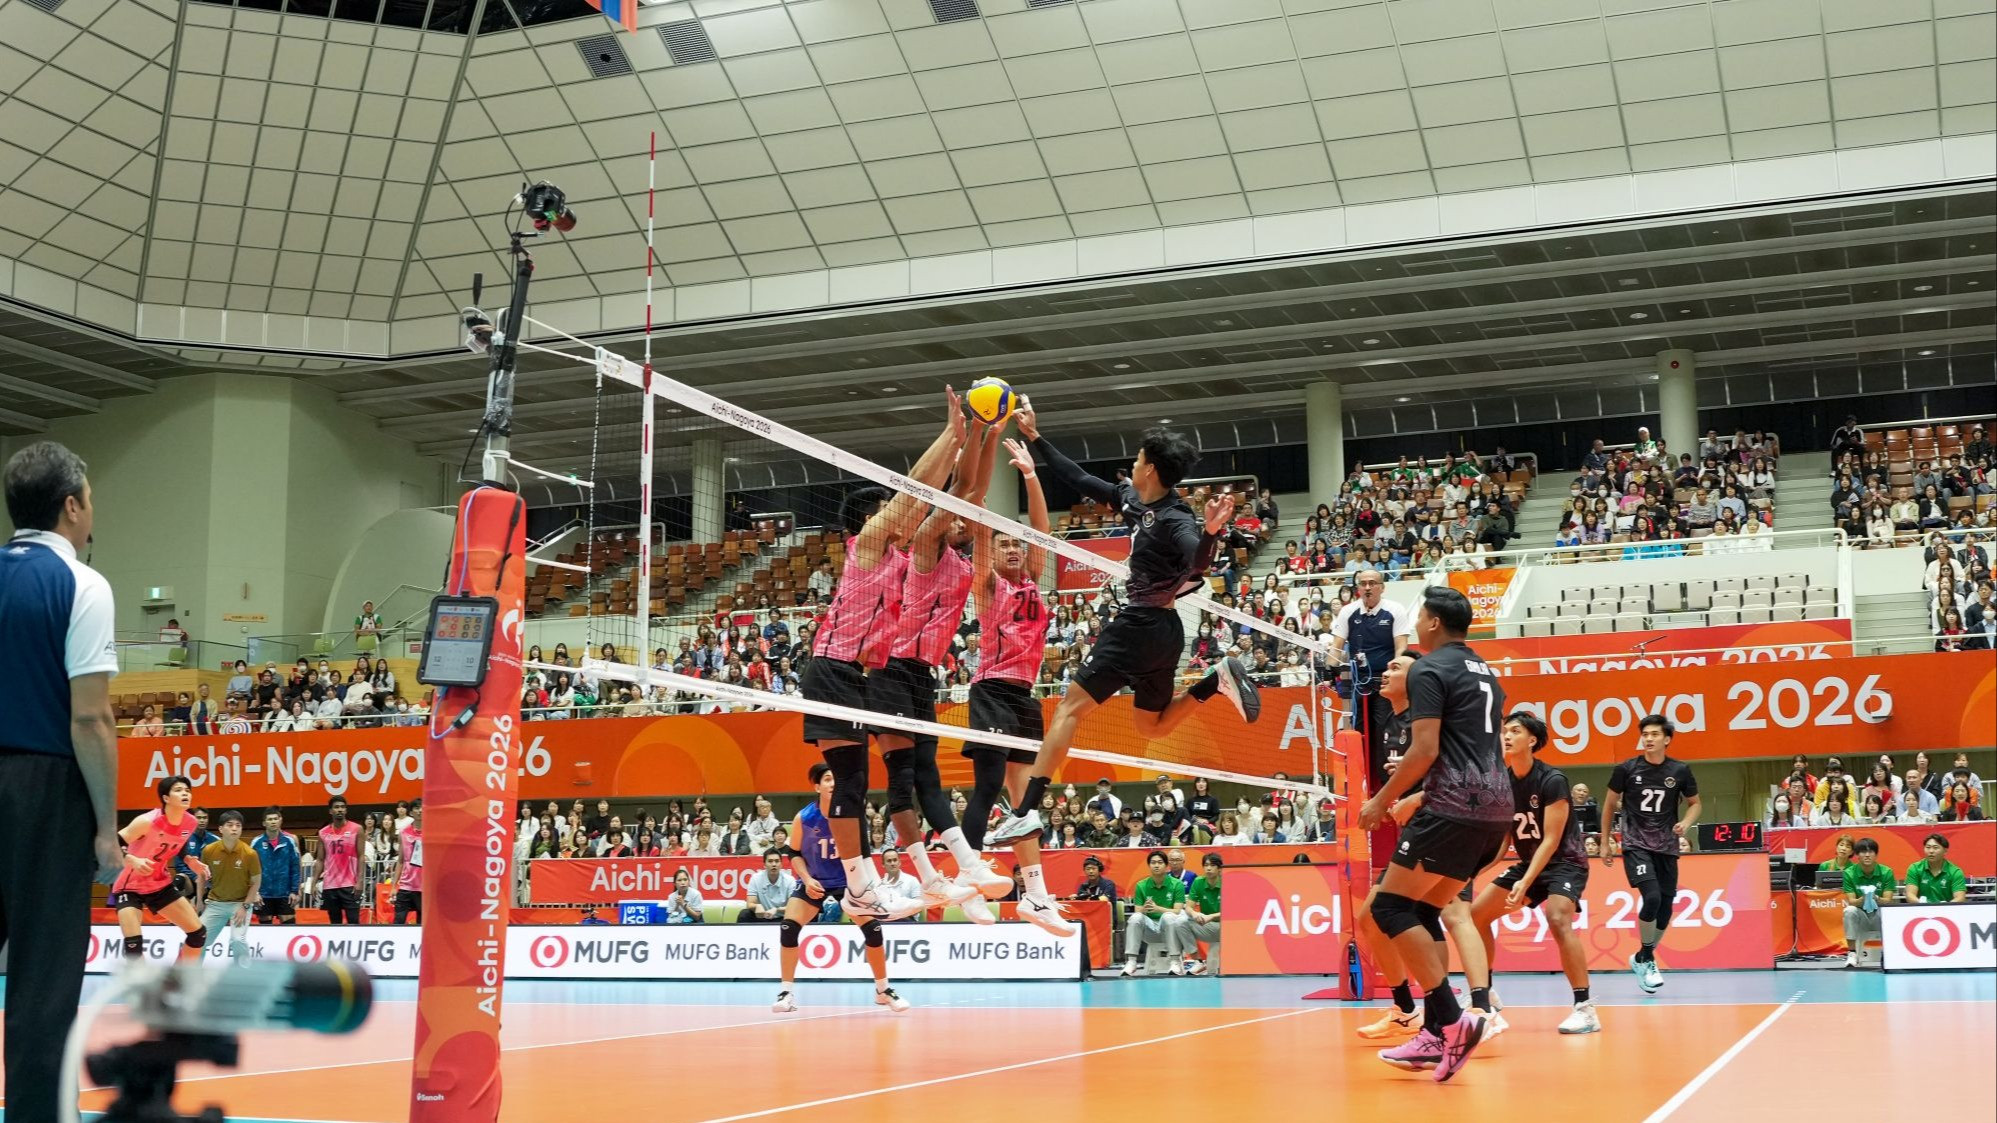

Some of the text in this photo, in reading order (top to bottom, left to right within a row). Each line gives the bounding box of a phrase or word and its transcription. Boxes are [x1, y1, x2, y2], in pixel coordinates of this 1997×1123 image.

[1468, 584, 1504, 594] Aichi-
[1012, 589, 1039, 622] 26
[1468, 596, 1502, 607] agoy
[1478, 680, 1494, 734] 7
[1727, 674, 1894, 731] 2026
[1279, 696, 1345, 750] Ai
[143, 743, 425, 796] Aichi-Nagoya
[1640, 788, 1666, 813] 27
[1513, 811, 1541, 840] 25
[329, 839, 344, 854] 15
[476, 714, 513, 1017] Aichi-Nagoya 2026
[1028, 870, 1040, 878] 23
[1636, 864, 1648, 876] 27
[1604, 889, 1734, 930] 226
[103, 938, 165, 959] MFG
[326, 939, 395, 962] MUFG
[574, 940, 649, 963] MUFG
[665, 942, 770, 960] MUFG Bank
[949, 941, 1065, 960] MUFG Bank
